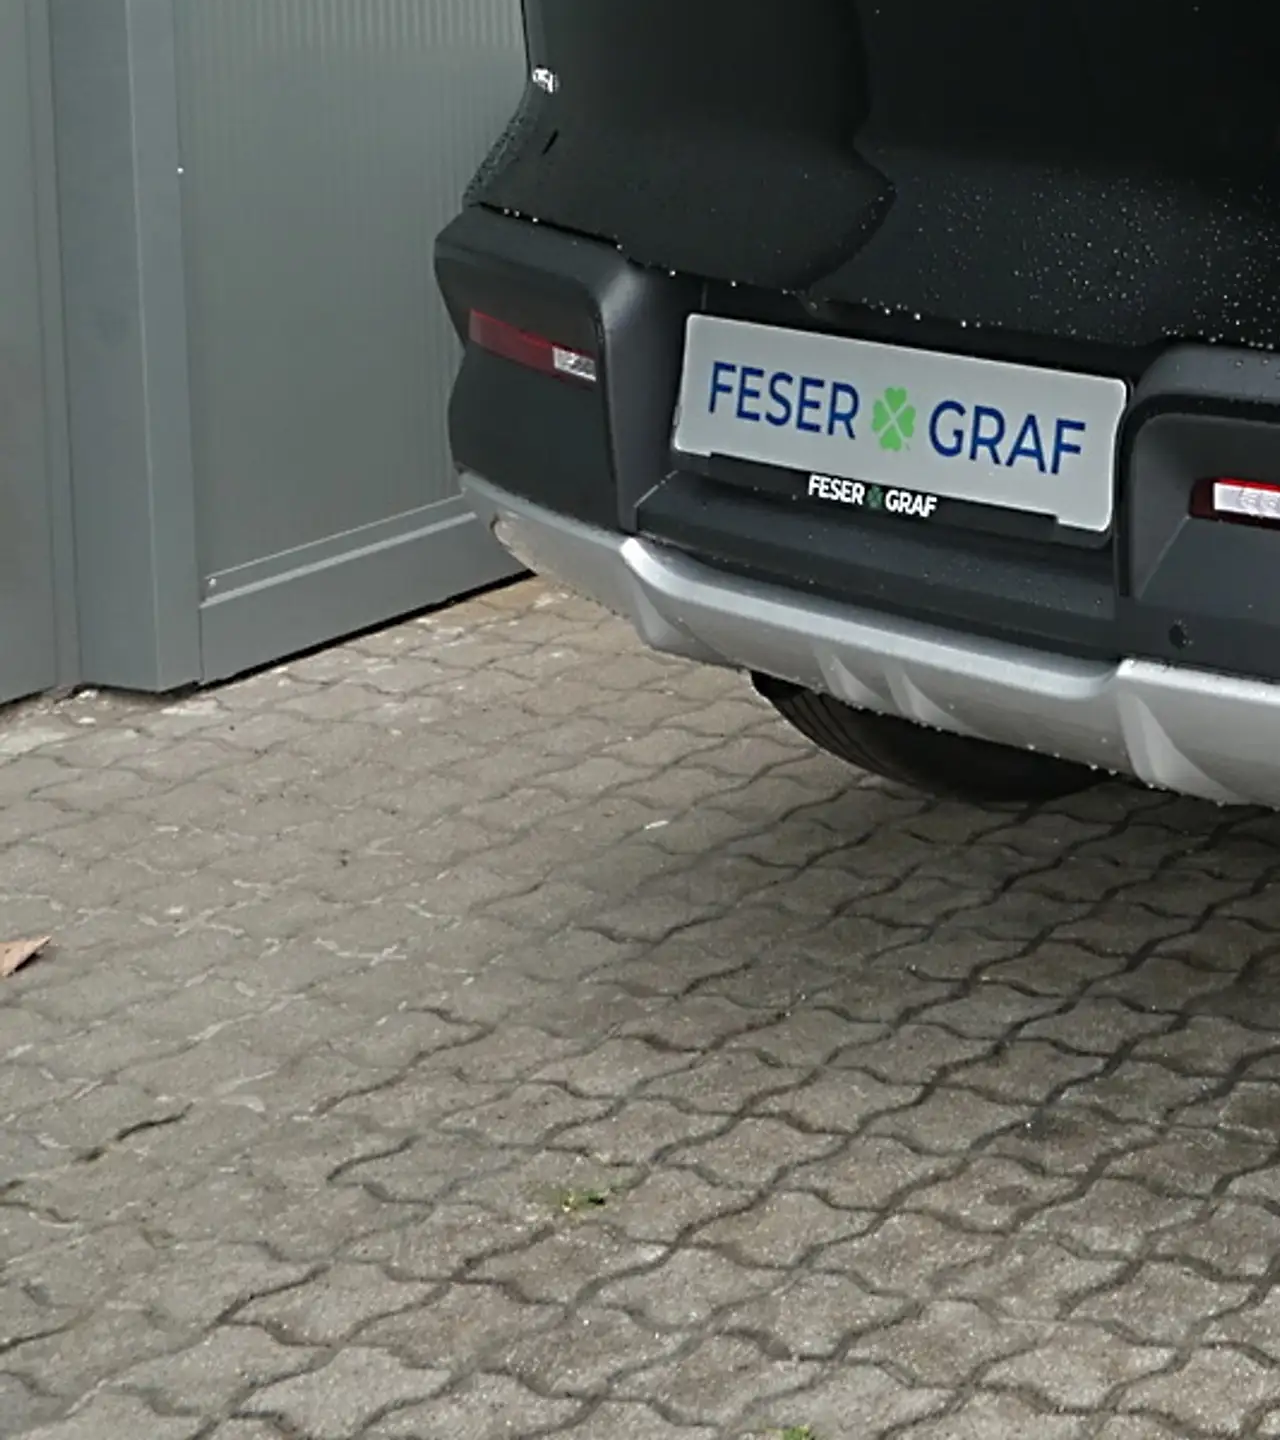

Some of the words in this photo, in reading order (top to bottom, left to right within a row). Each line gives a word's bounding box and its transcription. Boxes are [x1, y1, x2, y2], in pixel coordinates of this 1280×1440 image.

[707, 360, 860, 440] FESER
[928, 399, 1087, 475] GRAF
[808, 473, 866, 506] FESER
[885, 489, 938, 517] GRAF
